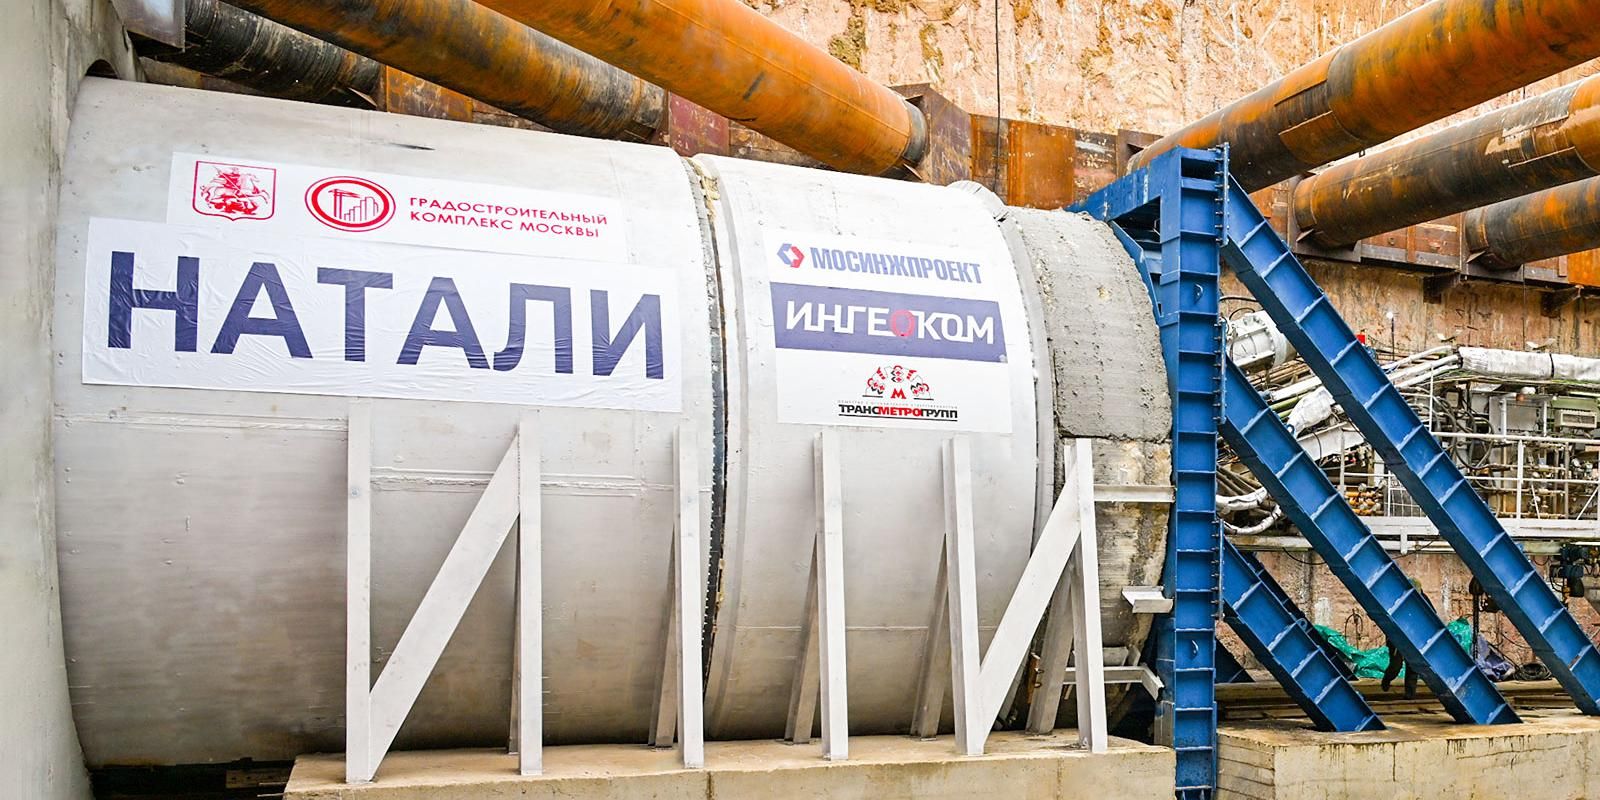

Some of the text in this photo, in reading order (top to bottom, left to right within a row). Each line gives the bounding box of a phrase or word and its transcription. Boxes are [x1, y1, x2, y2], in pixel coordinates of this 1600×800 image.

[410, 197, 607, 225] ГРАДОСТРОИТЕЛЬНЫЙ
[411, 211, 600, 238] КОМПЛЕКС МОСКВЫ
[810, 247, 982, 284] МОСИНЖПРОЕКТ
[107, 251, 664, 380] НАТАЛИ
[786, 300, 994, 344] ИНГЕОКОМ
[838, 404, 958, 418] ТРАНСМЕТРОГРУПП
